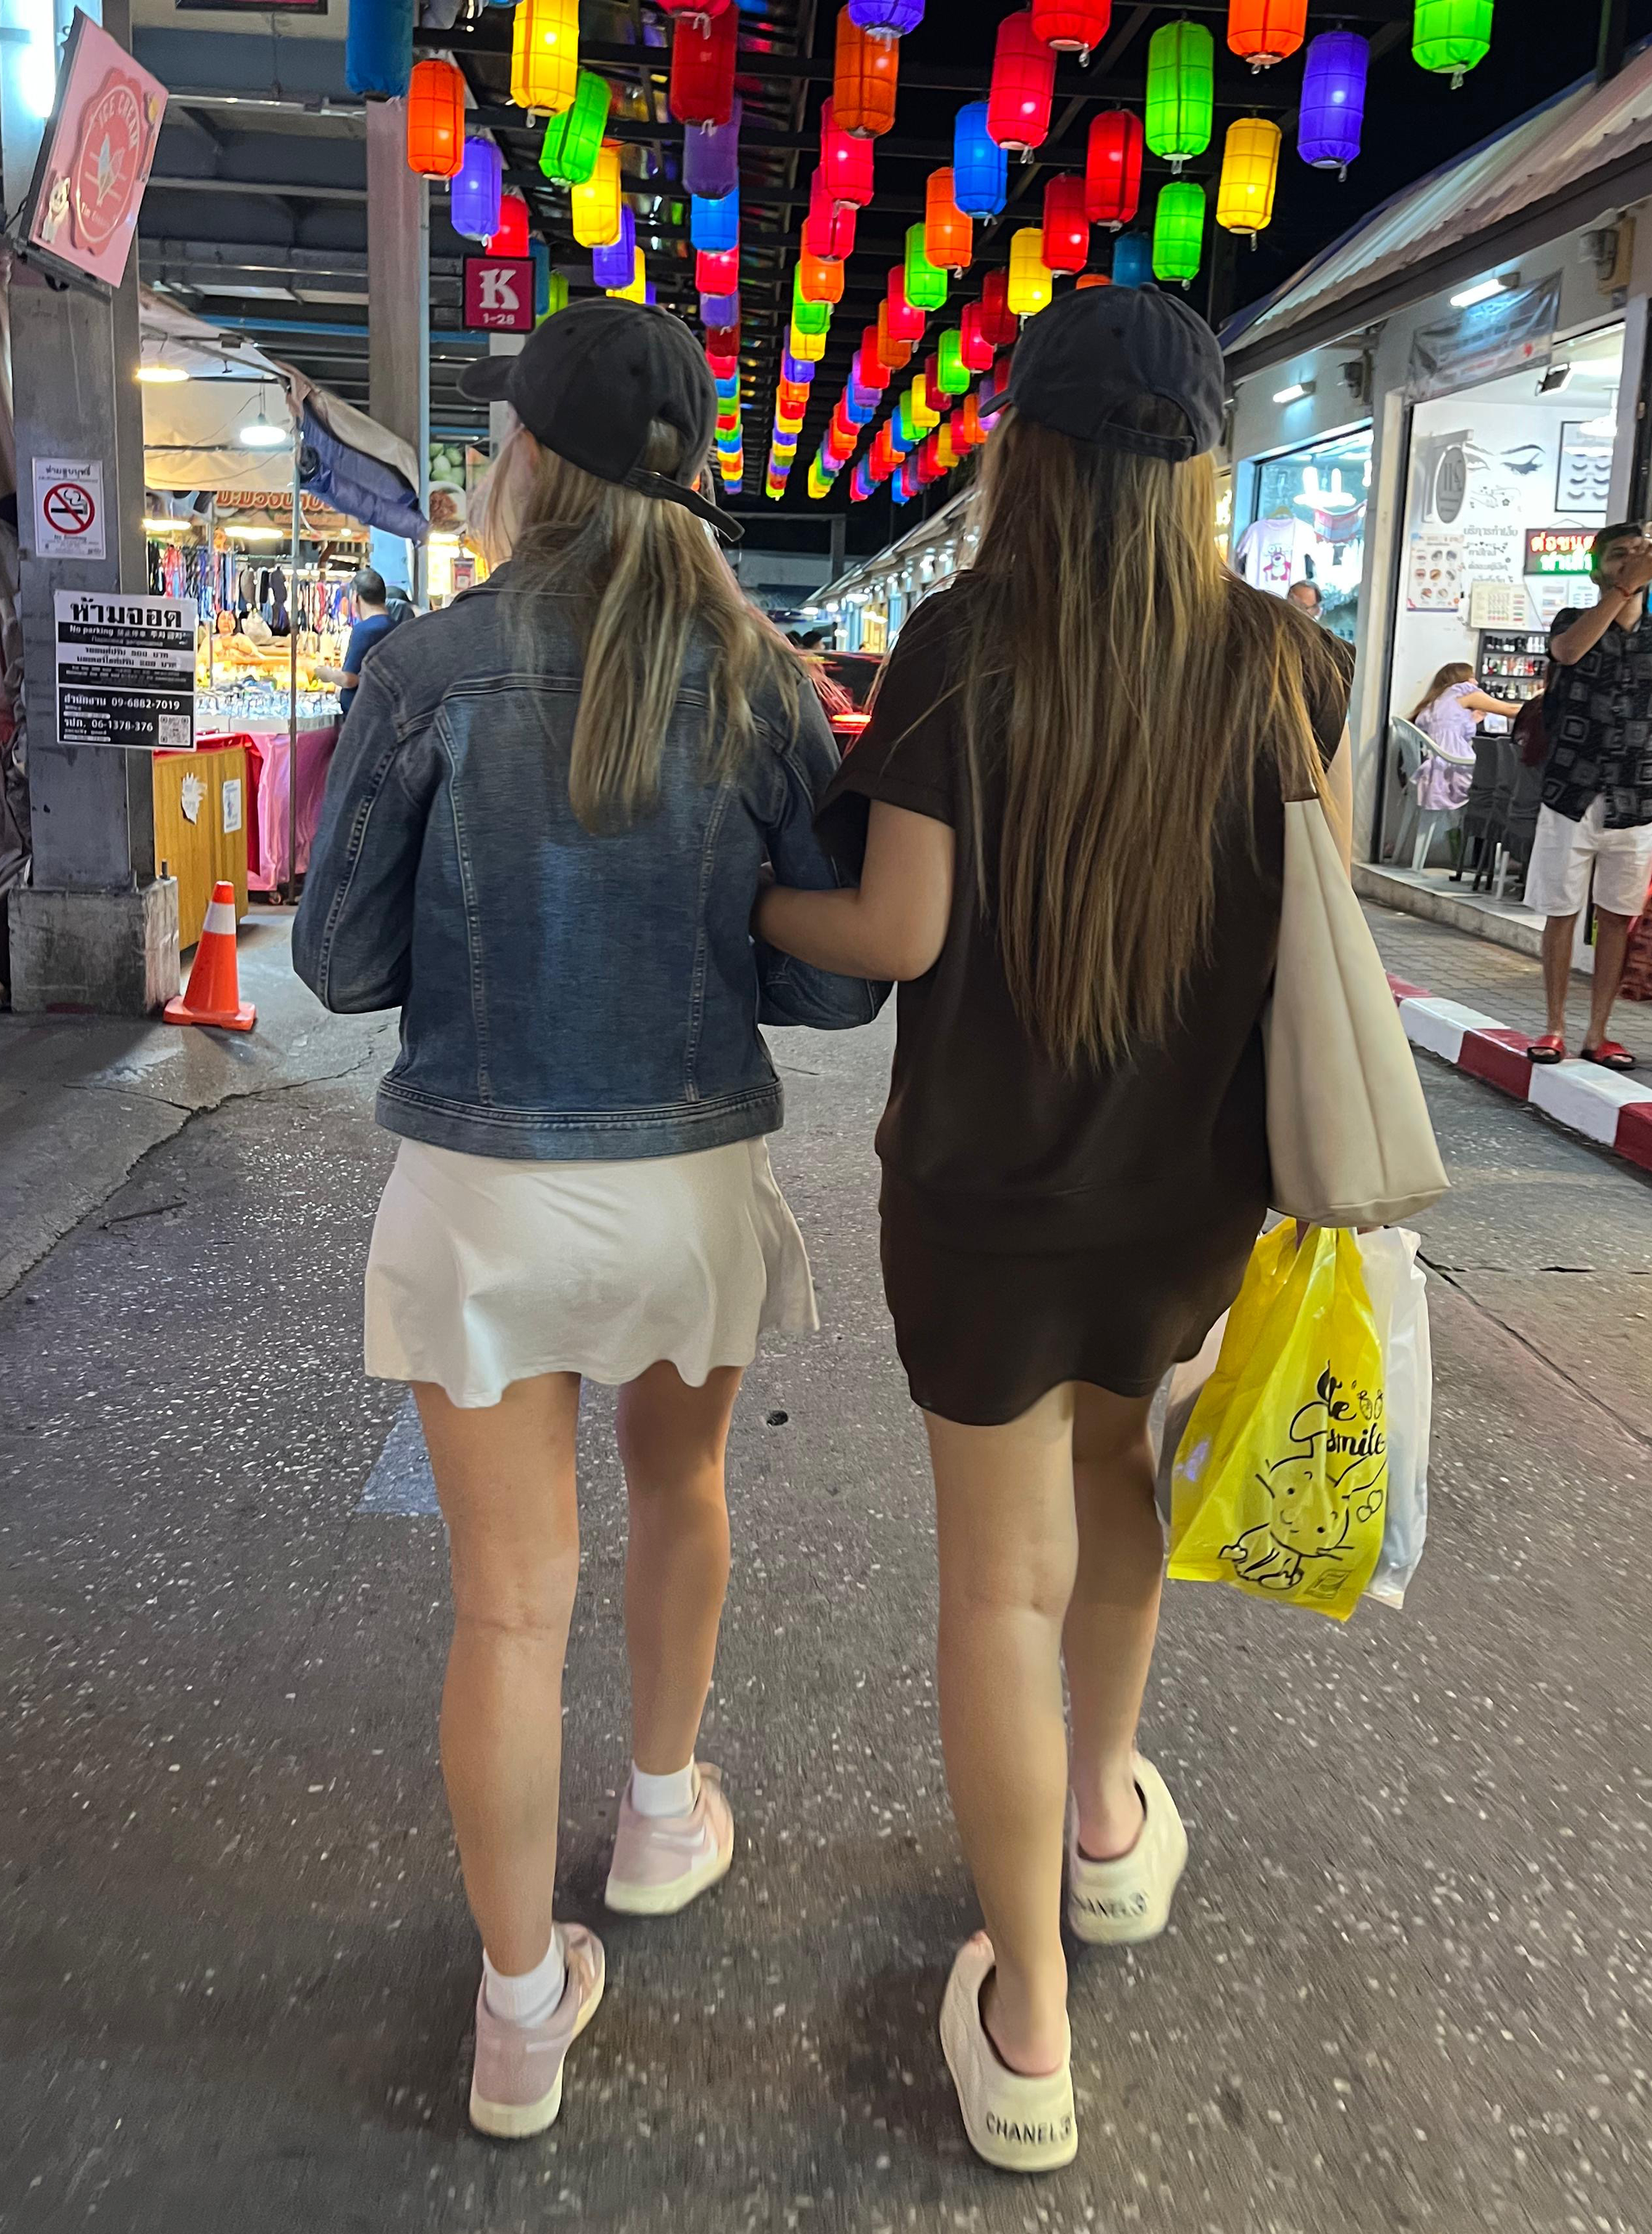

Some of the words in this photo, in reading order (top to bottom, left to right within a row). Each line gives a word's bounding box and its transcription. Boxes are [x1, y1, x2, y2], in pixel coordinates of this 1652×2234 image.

[478, 268, 520, 310] K
[483, 312, 515, 325] 1-28
[1530, 531, 1596, 552] ต่อขนต
[70, 596, 182, 628] ห้ามจอด
[69, 624, 82, 633] No
[83, 626, 114, 637] parking
